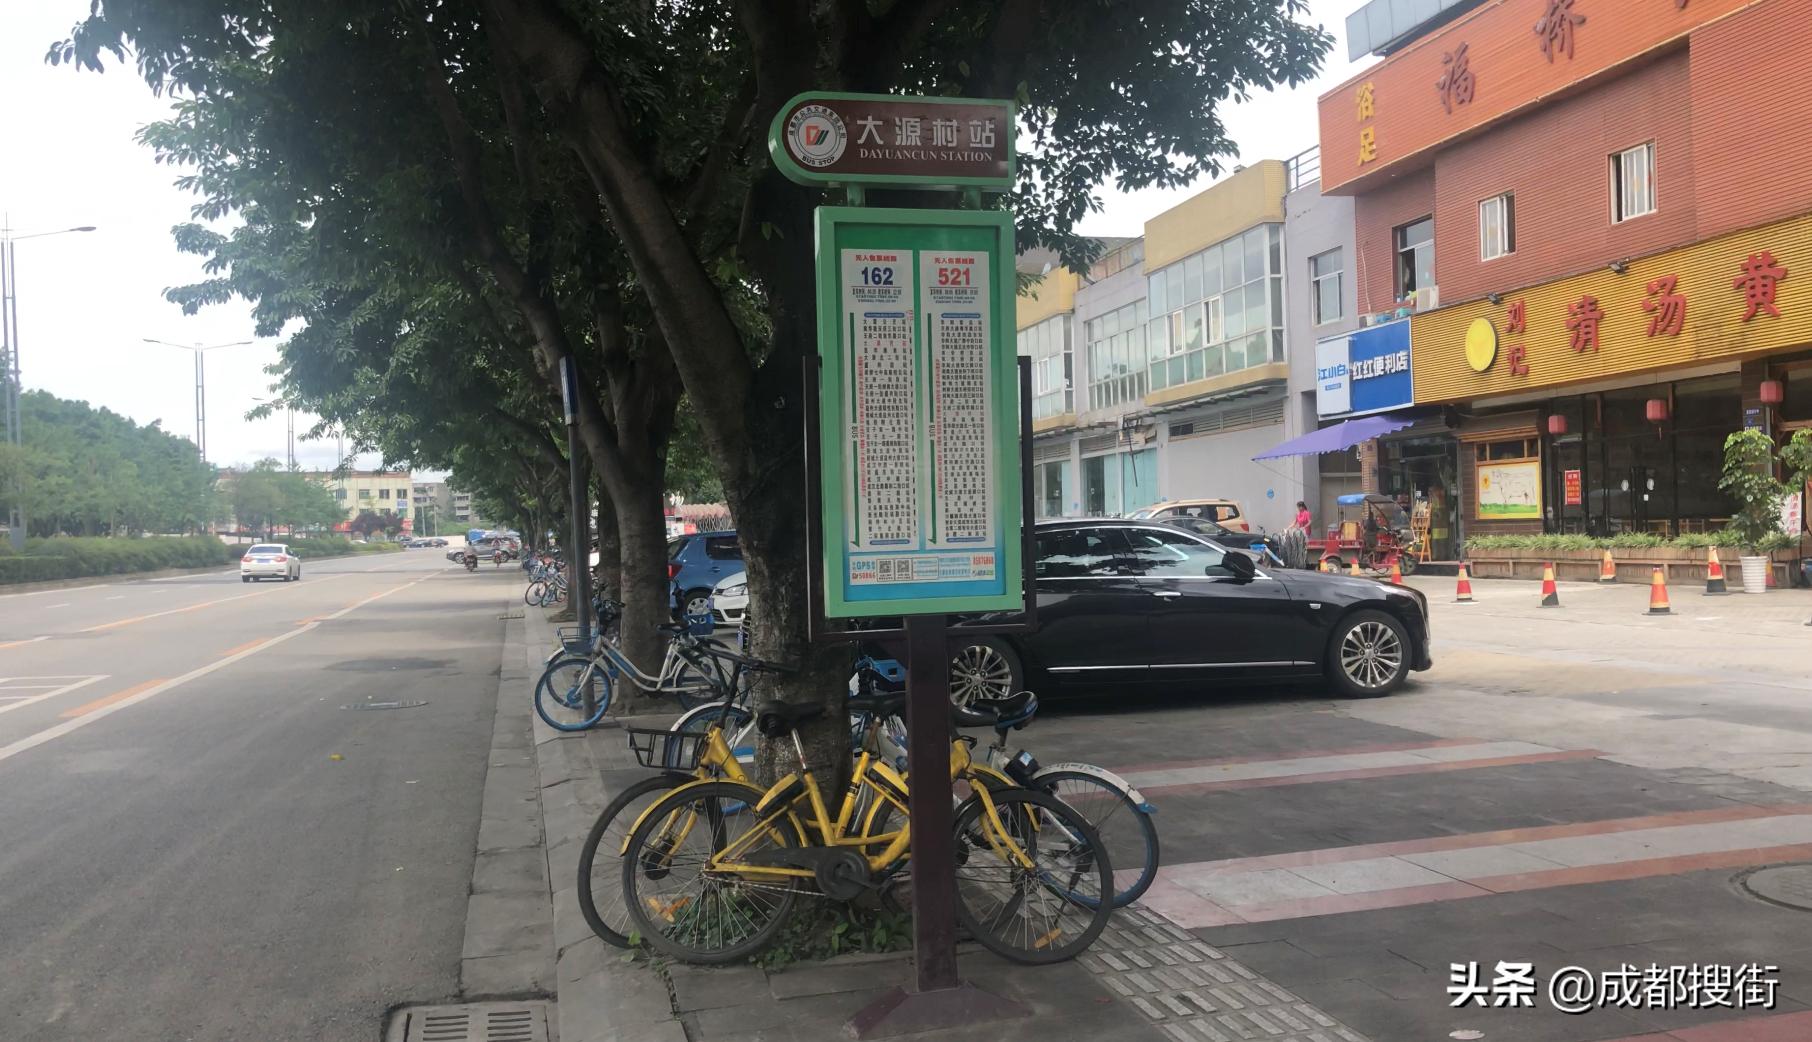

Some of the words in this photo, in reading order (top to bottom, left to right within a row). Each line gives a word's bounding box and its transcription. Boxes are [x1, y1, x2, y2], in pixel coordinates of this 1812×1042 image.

[856, 115, 995, 148] 大源村站
[802, 155, 815, 165] BUS
[818, 156, 835, 166] STOP
[860, 148, 938, 161] DAYUANCUN
[941, 151, 992, 162] STATION
[861, 266, 894, 286] 162
[938, 267, 970, 286] 521
[1317, 363, 1347, 381] 江小白
[1352, 350, 1410, 380] 红红便利店
